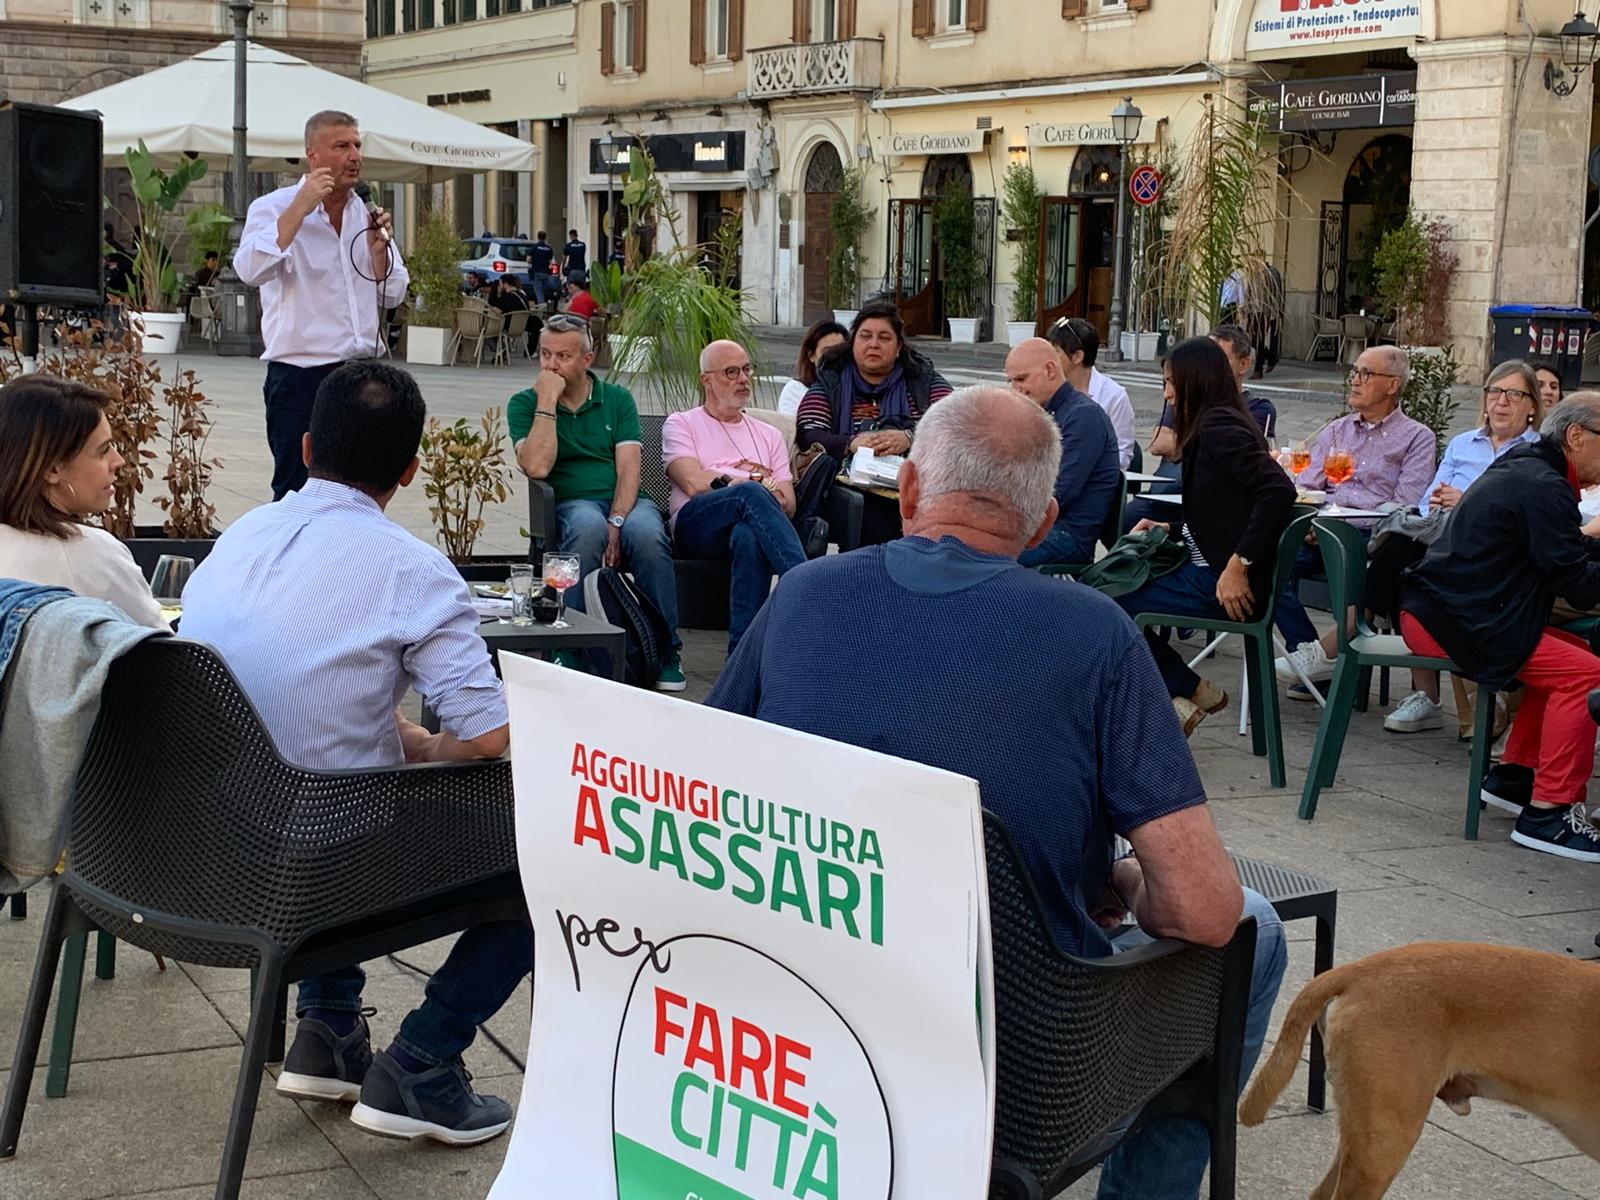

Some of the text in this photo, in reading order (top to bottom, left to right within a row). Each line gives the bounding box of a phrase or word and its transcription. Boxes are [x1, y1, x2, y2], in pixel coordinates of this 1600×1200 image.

[1254, 18, 1285, 33] Sistemi
[1286, 16, 1295, 29] di
[1297, 12, 1344, 28] Protezione
[1289, 23, 1383, 41] www.laspsystem.com
[1284, 89, 1381, 109] CAFÈ GIORDANO
[1311, 109, 1350, 120] LOUNGE BAR
[444, 144, 502, 159] GIORDANO
[919, 134, 971, 151] GIORDANO
[571, 743, 884, 869] AGGIUNGICULTURA
[556, 909, 672, 992] per
[654, 986, 812, 1119] FARE
[670, 1070, 840, 1200] CITTÀ
